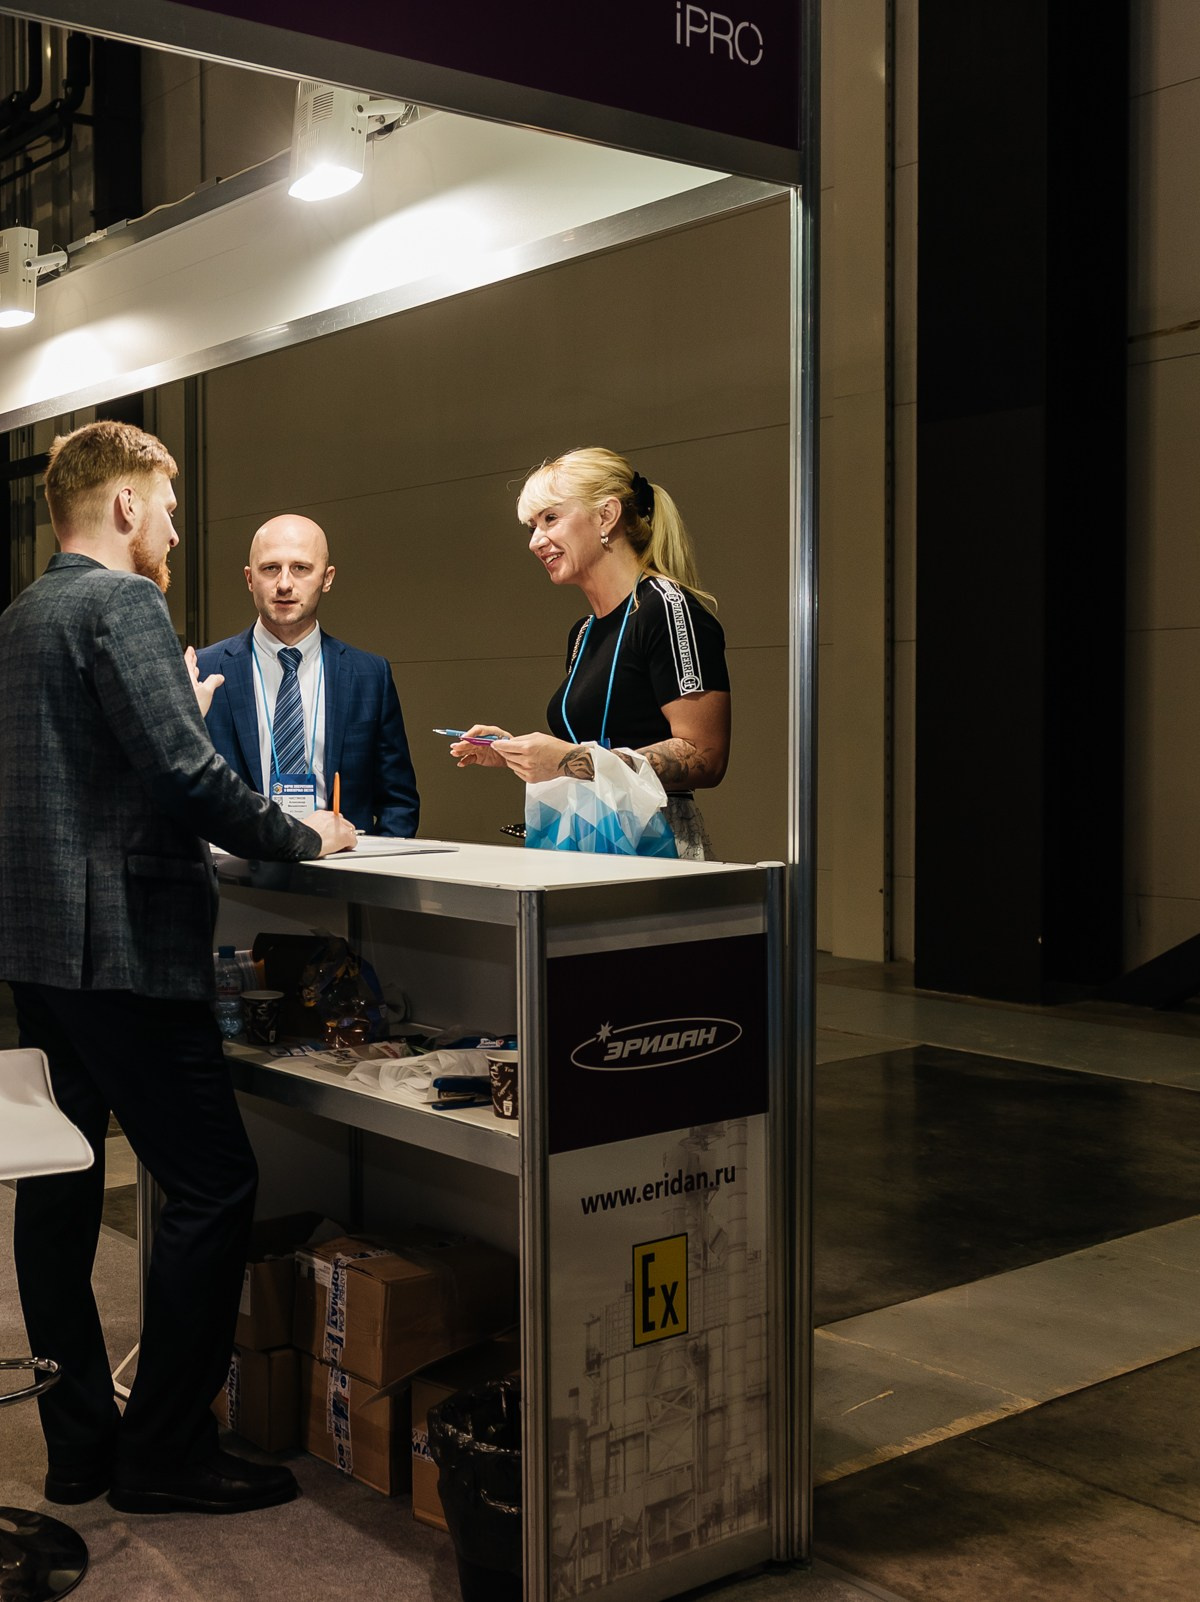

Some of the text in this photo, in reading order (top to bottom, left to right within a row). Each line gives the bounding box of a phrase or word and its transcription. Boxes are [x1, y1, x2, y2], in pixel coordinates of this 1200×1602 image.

[676, 1, 764, 66] iPRO
[603, 1026, 718, 1062] ЭРИДАН
[580, 1164, 737, 1216] www.eridan.ru
[642, 1252, 679, 1333] Ex
